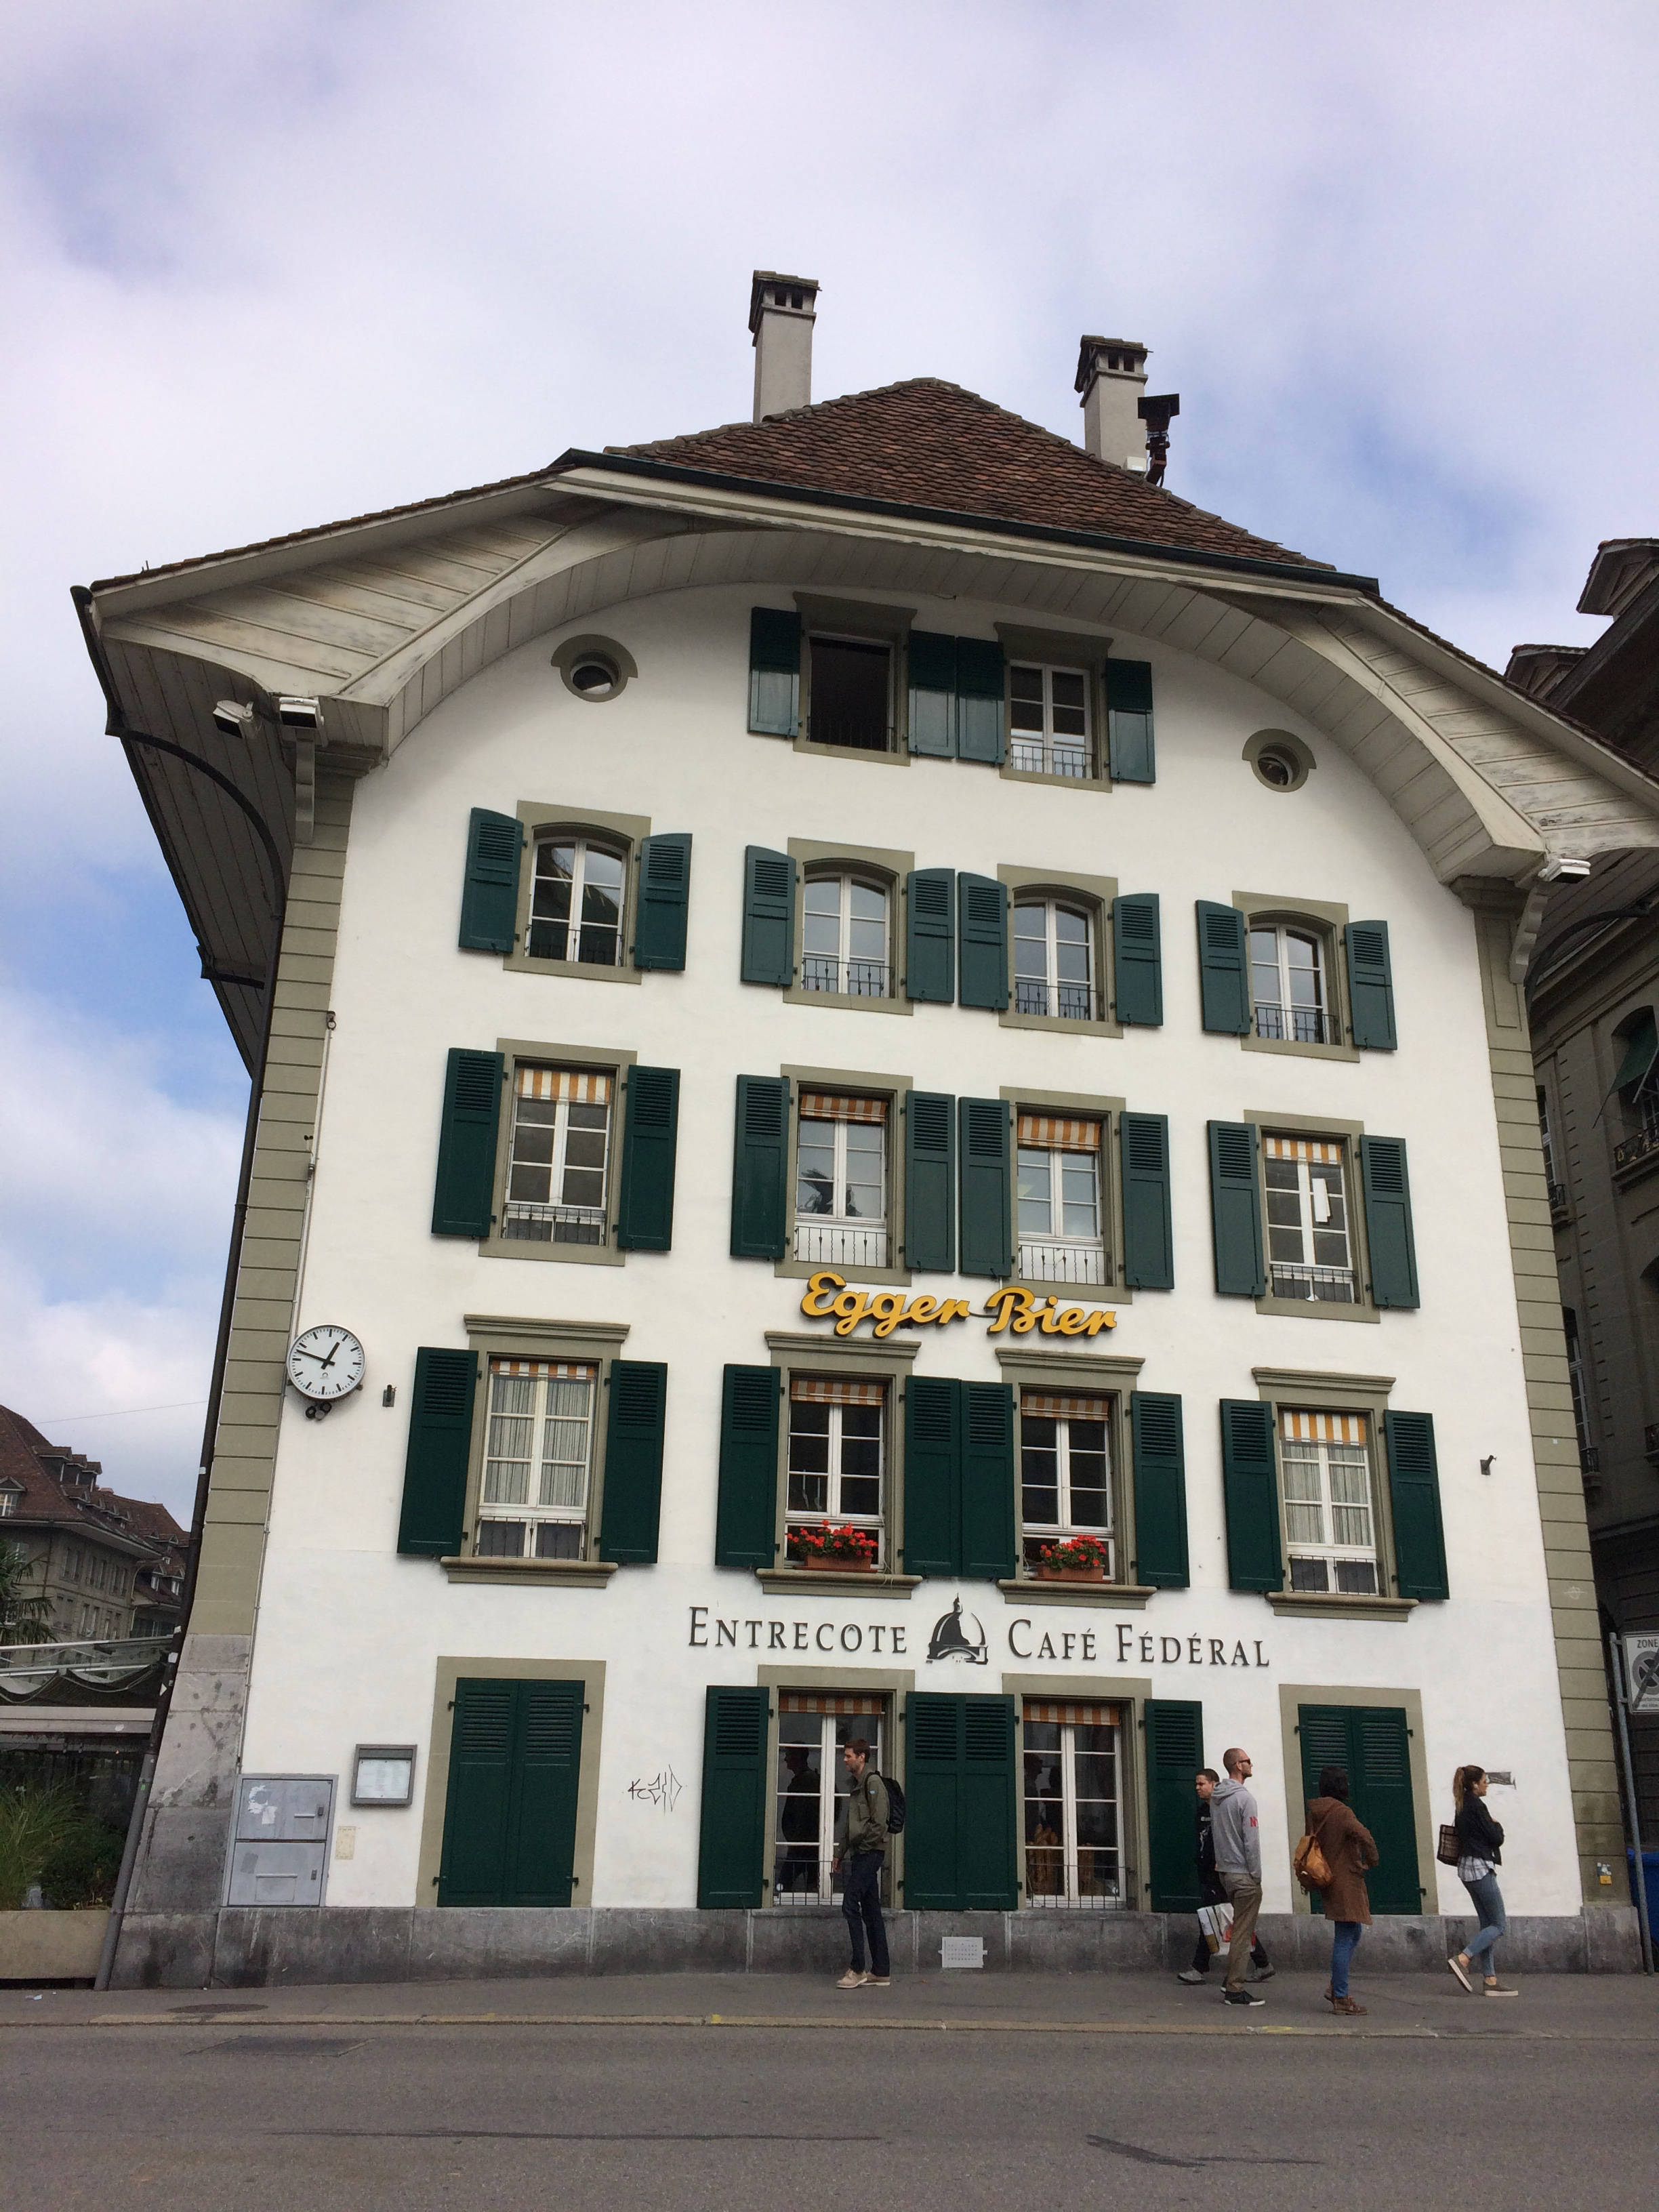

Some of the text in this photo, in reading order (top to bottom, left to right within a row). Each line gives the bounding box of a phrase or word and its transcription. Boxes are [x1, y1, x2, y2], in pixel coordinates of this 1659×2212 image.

[801, 1271, 1117, 1337] Egger Bier
[1008, 1618, 1097, 1660] CAFÉ
[1115, 1624, 1269, 1667] FÉDÉRAL
[1637, 1639, 1658, 1648] ZONE
